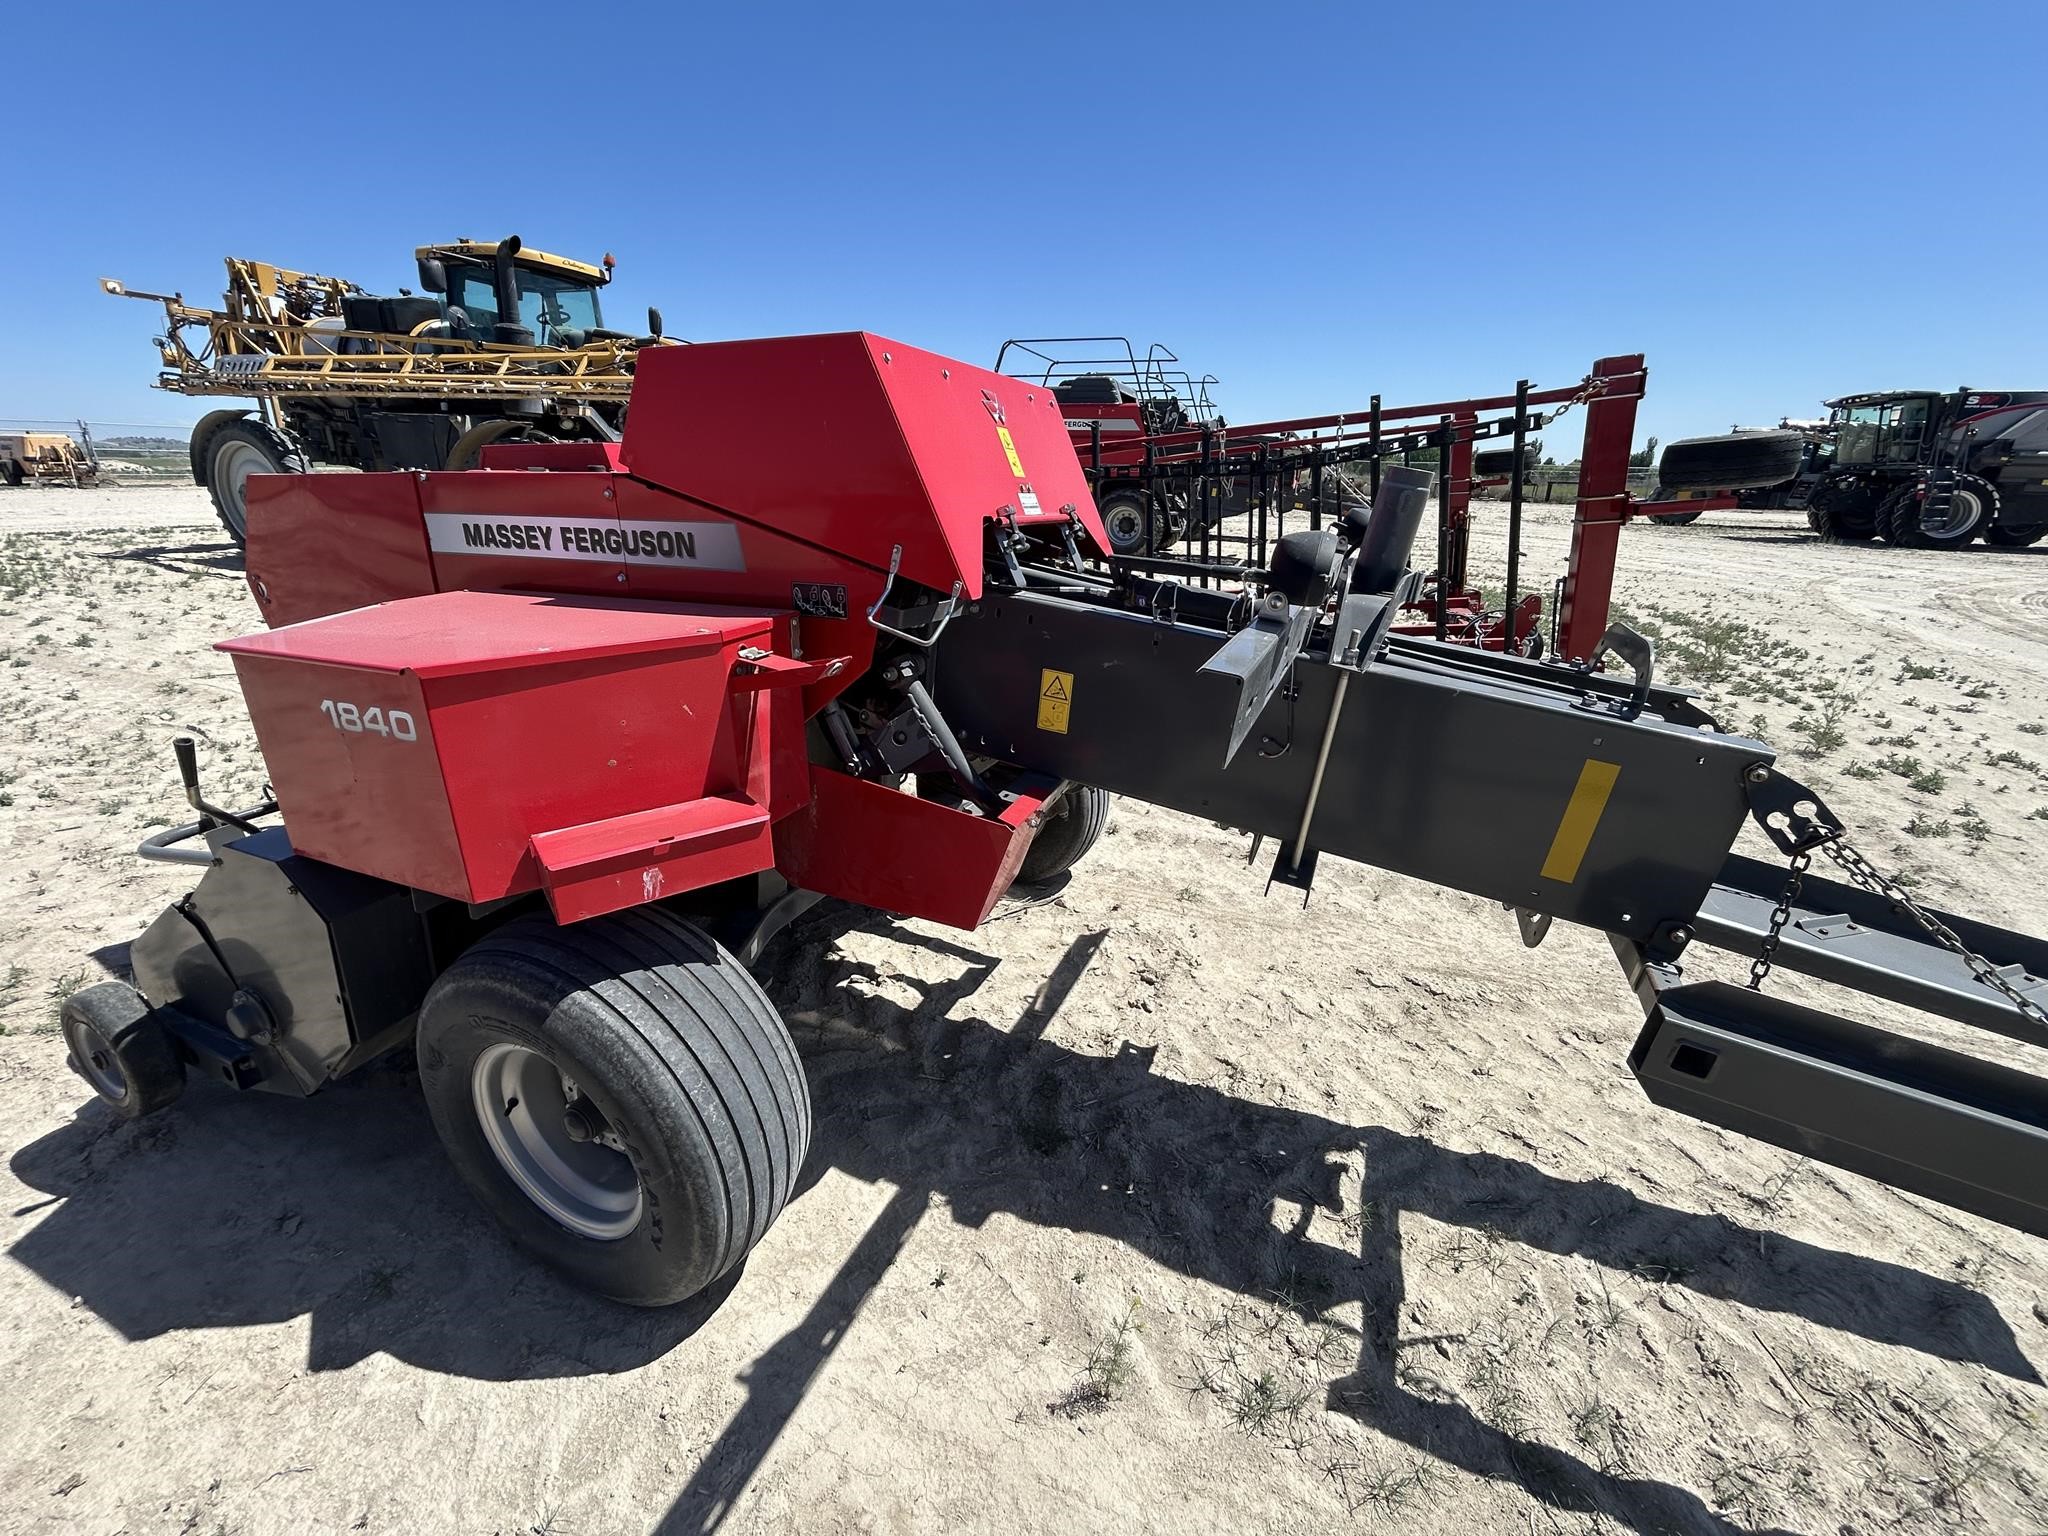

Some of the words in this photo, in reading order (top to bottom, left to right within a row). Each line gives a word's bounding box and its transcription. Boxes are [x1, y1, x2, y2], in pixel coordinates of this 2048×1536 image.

[462, 523, 552, 550] MASSEY
[560, 527, 696, 559] FERGUSON
[320, 699, 417, 741] 1840
